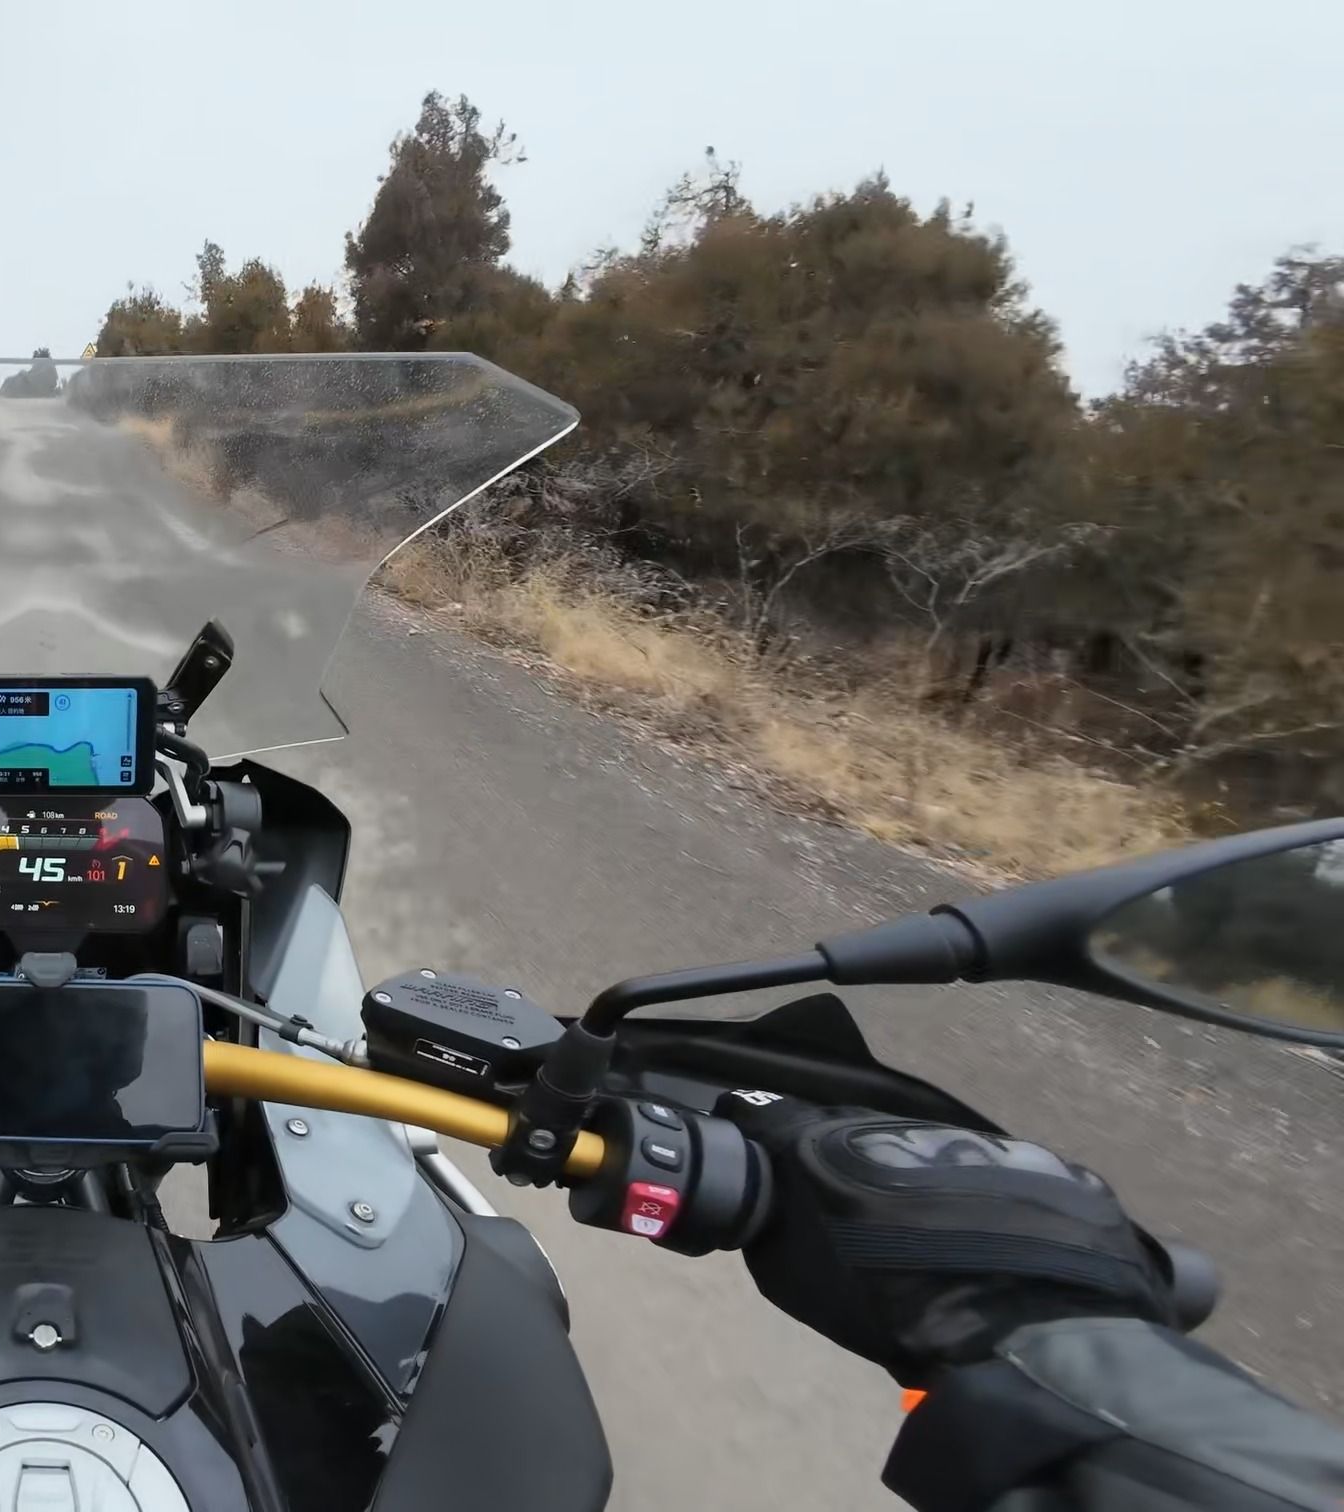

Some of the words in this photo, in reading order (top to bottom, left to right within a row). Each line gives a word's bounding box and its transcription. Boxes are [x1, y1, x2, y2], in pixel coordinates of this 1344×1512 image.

[94, 812, 118, 820] ROAD
[1, 825, 10, 833] 4
[21, 825, 30, 834] 5
[18, 857, 66, 882] 45
[117, 861, 127, 880] 1
[87, 870, 105, 881] 101
[113, 904, 136, 913] 13:19
